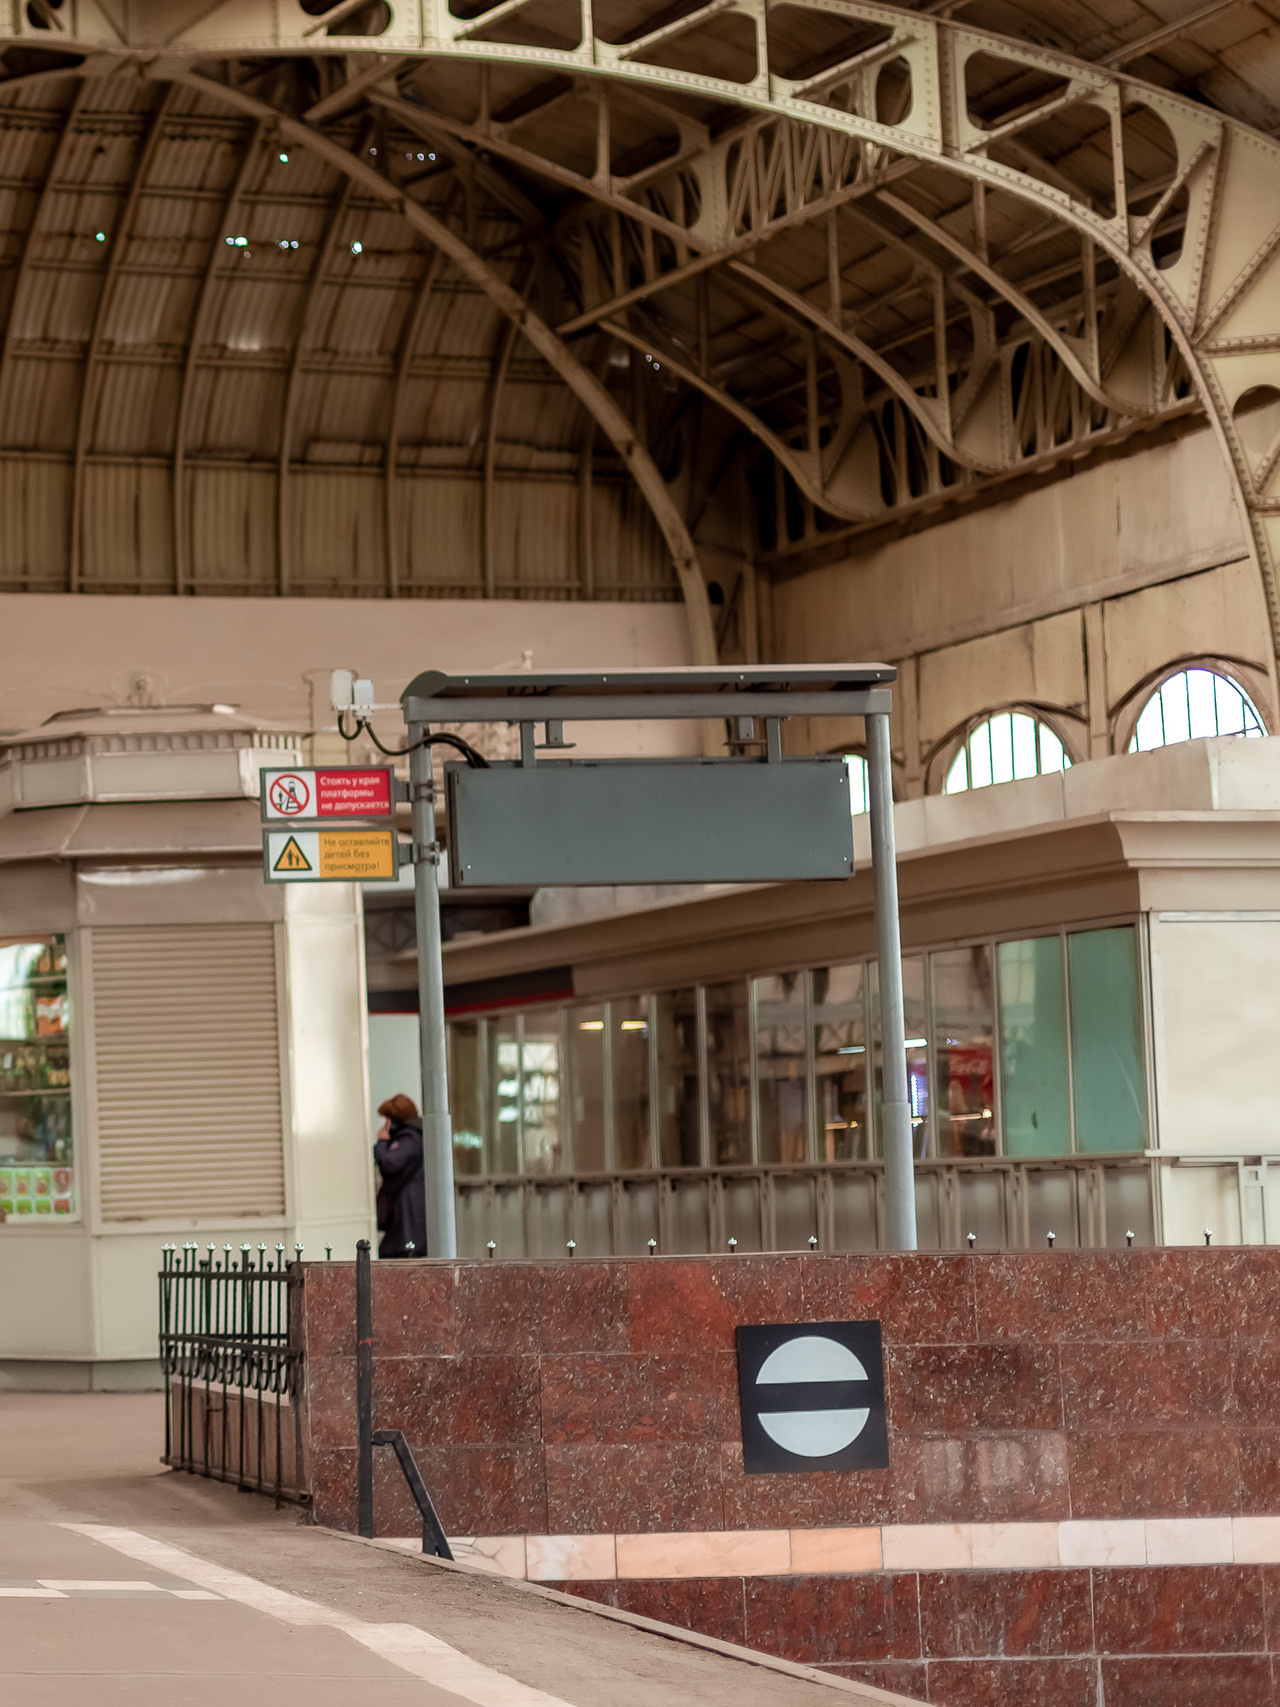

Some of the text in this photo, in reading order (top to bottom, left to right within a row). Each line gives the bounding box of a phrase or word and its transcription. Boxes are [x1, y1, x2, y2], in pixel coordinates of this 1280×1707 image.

[320, 776, 351, 787] Стоять
[359, 776, 380, 786] края
[320, 789, 374, 799] платформы
[321, 801, 390, 811] не допускается
[338, 837, 390, 847] оставляйте
[324, 849, 370, 859] детей без
[324, 861, 380, 872] присмотра!
